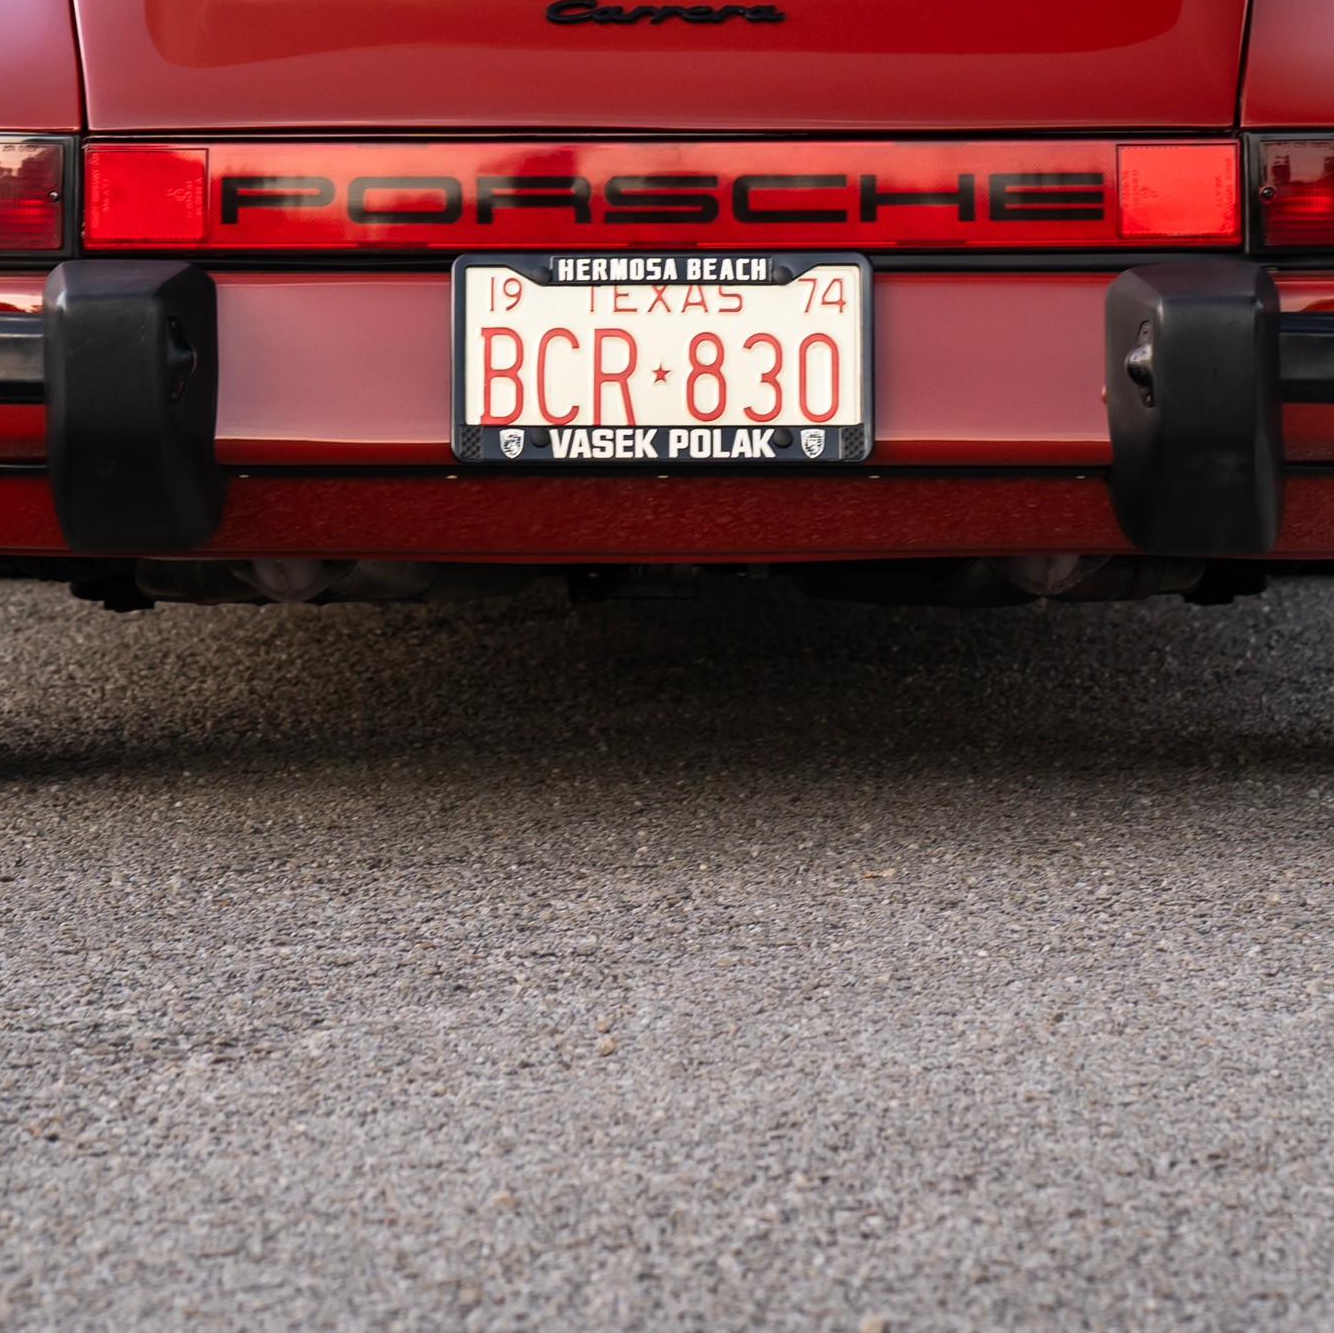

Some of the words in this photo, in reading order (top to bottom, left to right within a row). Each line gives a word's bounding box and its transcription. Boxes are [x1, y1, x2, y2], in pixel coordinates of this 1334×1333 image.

[221, 173, 1104, 224] PORSCHE
[558, 258, 677, 282] HERMOSA
[686, 258, 767, 282] BEACH
[491, 277, 522, 312] 19
[798, 277, 847, 313] 74
[549, 428, 658, 459] VASEK
[672, 428, 776, 459] POLAK
